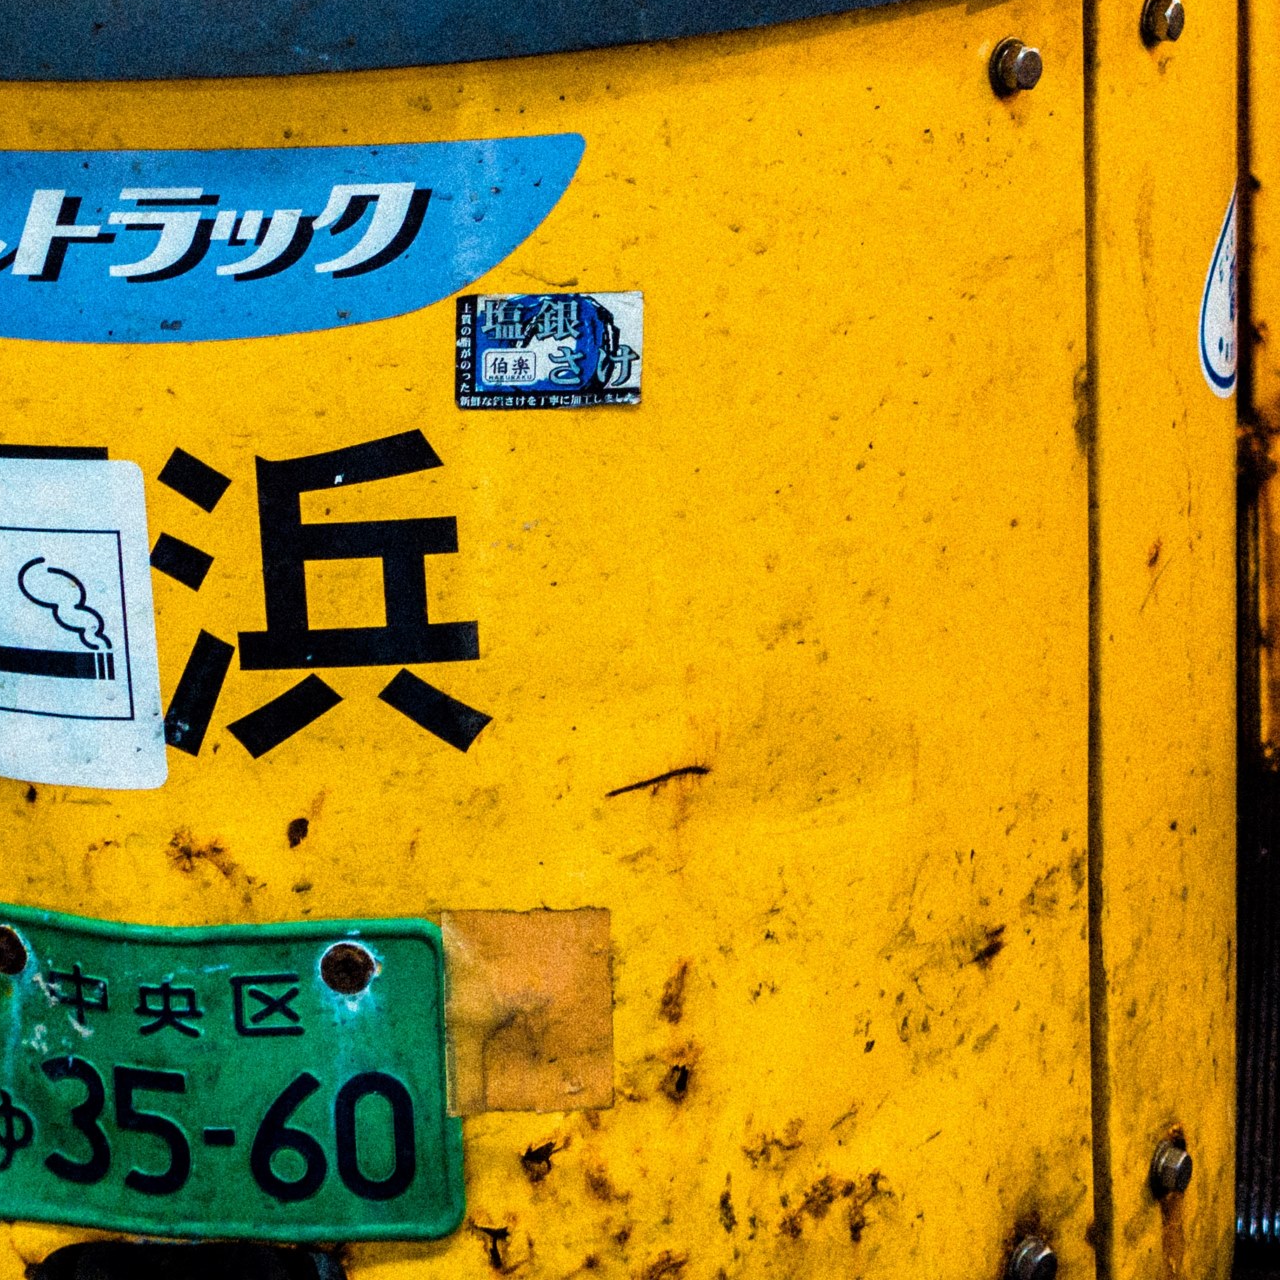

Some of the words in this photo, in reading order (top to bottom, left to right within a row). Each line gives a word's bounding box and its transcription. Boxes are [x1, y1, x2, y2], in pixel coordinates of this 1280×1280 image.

[480, 299, 581, 341] 塩銀
[489, 355, 531, 375] 伯楽
[548, 344, 641, 387] さけ
[48, 963, 306, 1038] 中央区
[40, 1056, 417, 1202] 35-60
